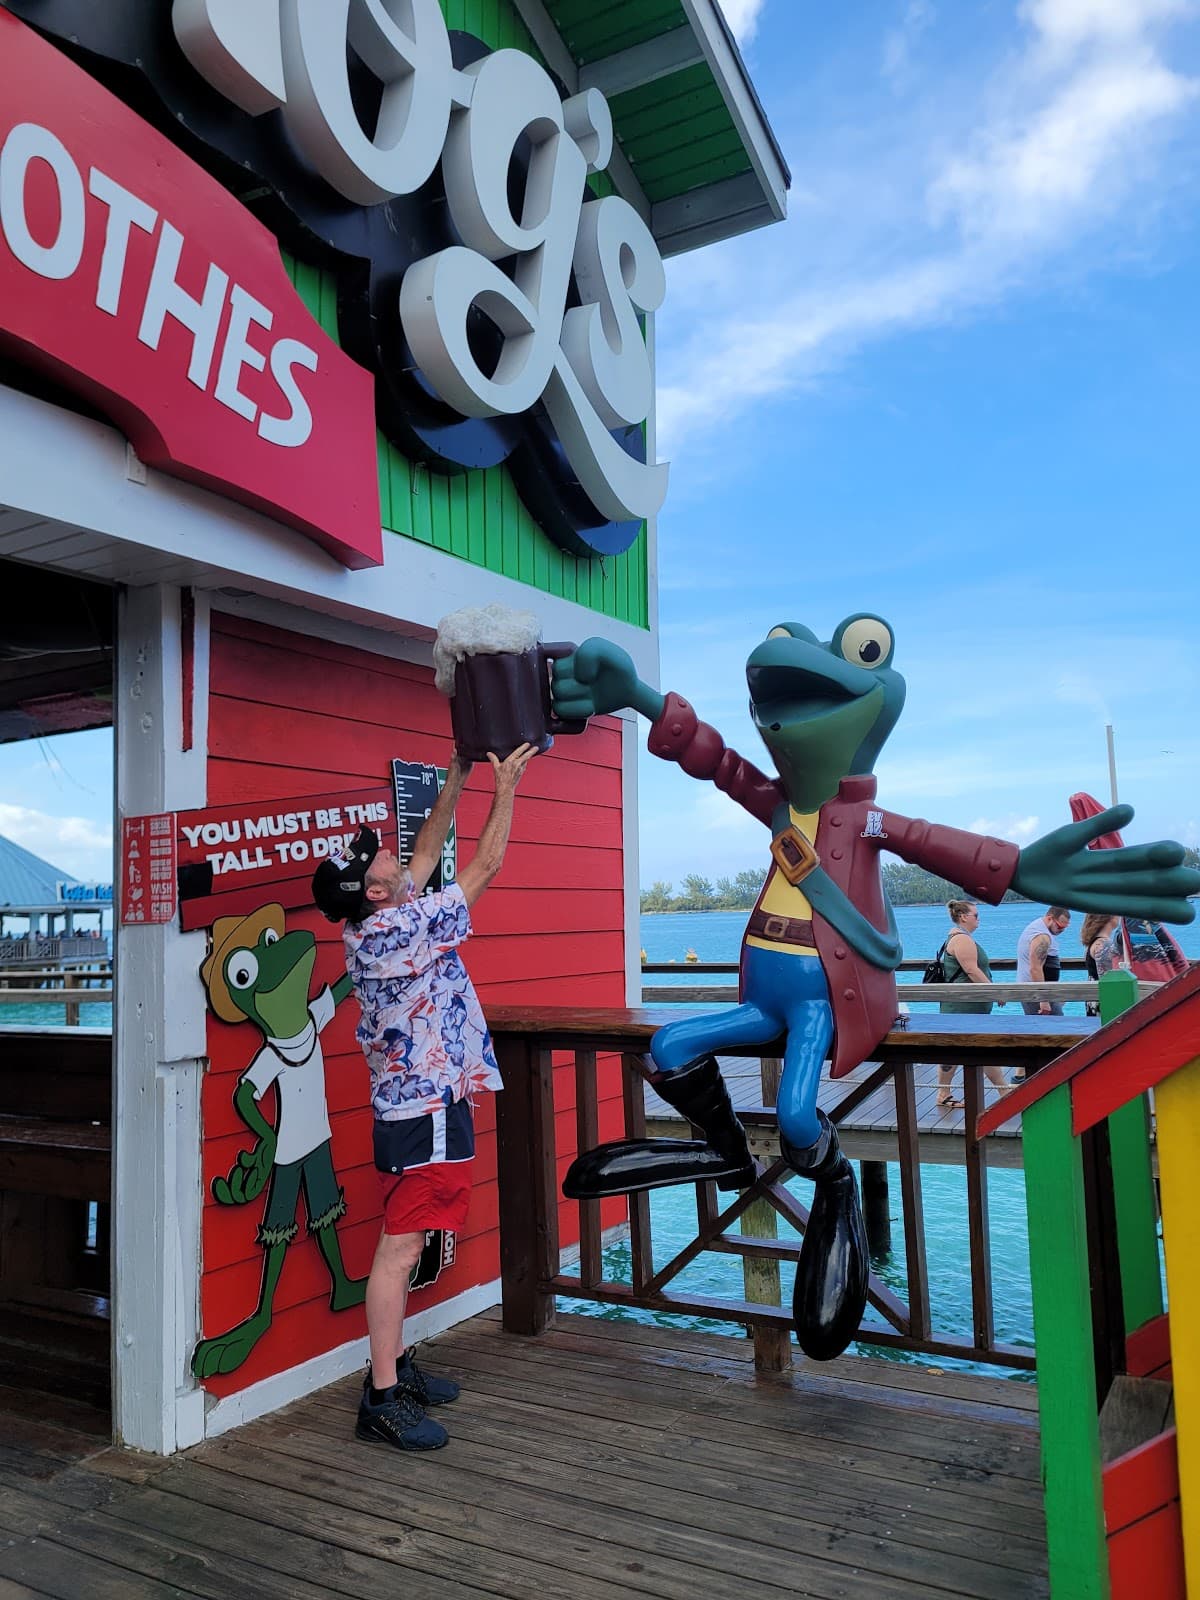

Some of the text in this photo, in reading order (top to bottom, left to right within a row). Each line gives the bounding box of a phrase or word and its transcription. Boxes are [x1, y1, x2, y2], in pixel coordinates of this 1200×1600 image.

[0, 123, 319, 447] OTHES
[182, 820, 241, 848] YOU
[244, 811, 311, 840] MUST
[315, 808, 343, 830] BE
[344, 802, 389, 825] THIS
[205, 847, 272, 875] TALL
[275, 840, 308, 864] TO
[312, 828, 383, 859] DRI!
